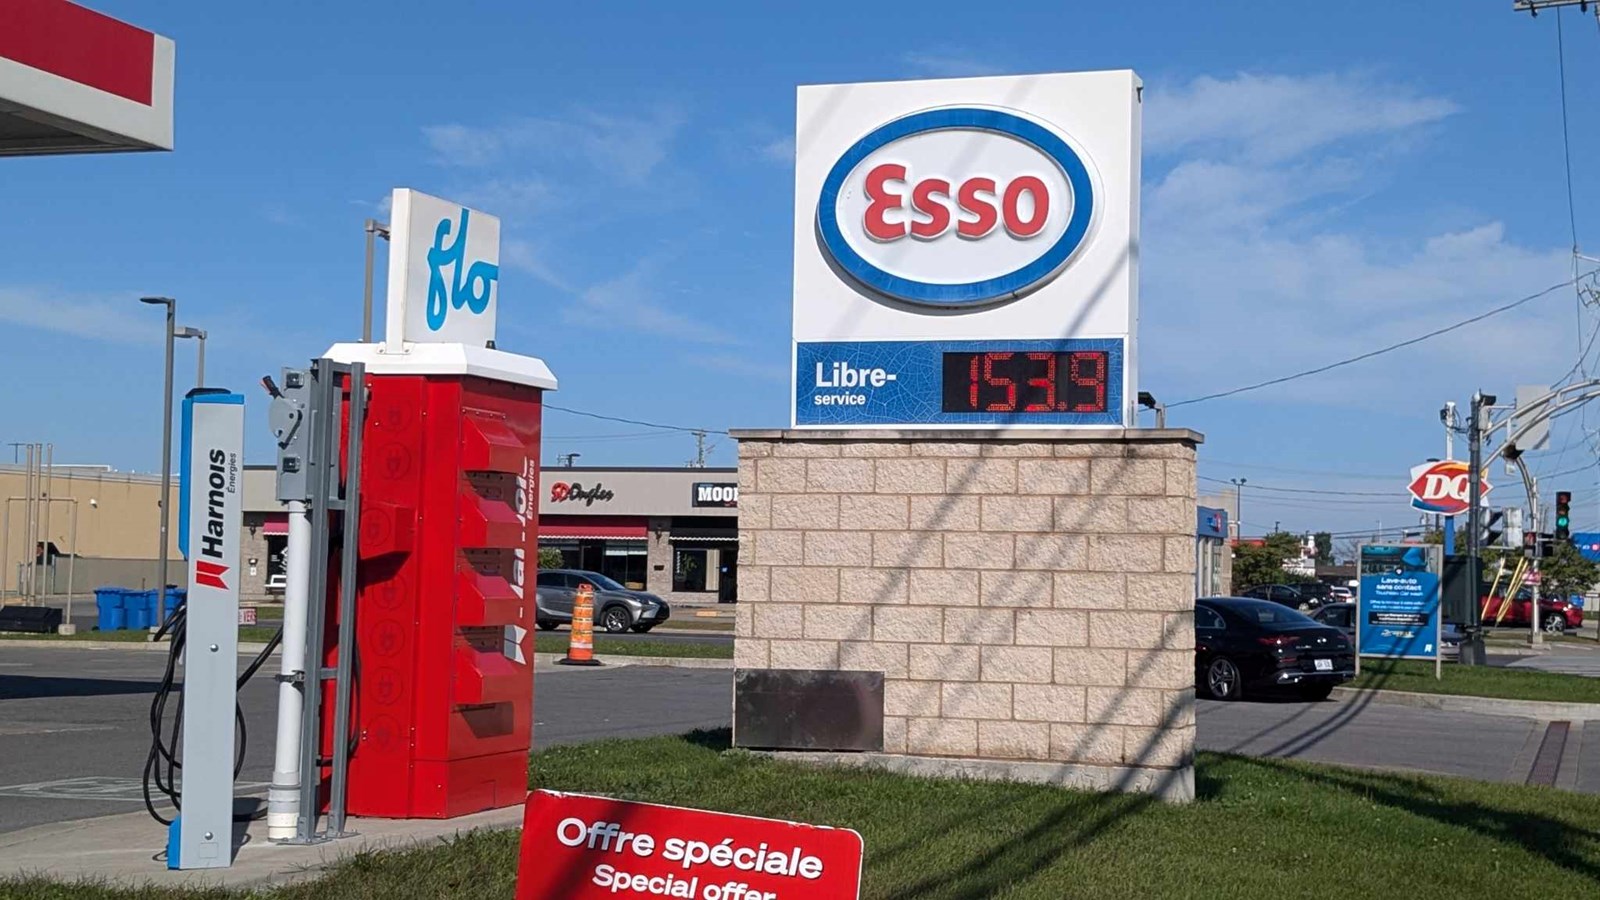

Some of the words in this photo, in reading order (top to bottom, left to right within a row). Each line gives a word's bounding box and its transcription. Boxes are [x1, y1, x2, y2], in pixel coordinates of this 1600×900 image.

[427, 208, 498, 331] flo
[814, 393, 866, 406] service
[815, 362, 896, 387] Libre-
[969, 352, 1104, 412] 153.9
[226, 453, 238, 493] Énergies
[525, 459, 535, 520] Énergies
[1422, 473, 1470, 503] DQ
[202, 449, 225, 558] Harnois
[556, 817, 655, 857] Offre
[662, 837, 824, 880] spéciale
[592, 864, 698, 900] Special
